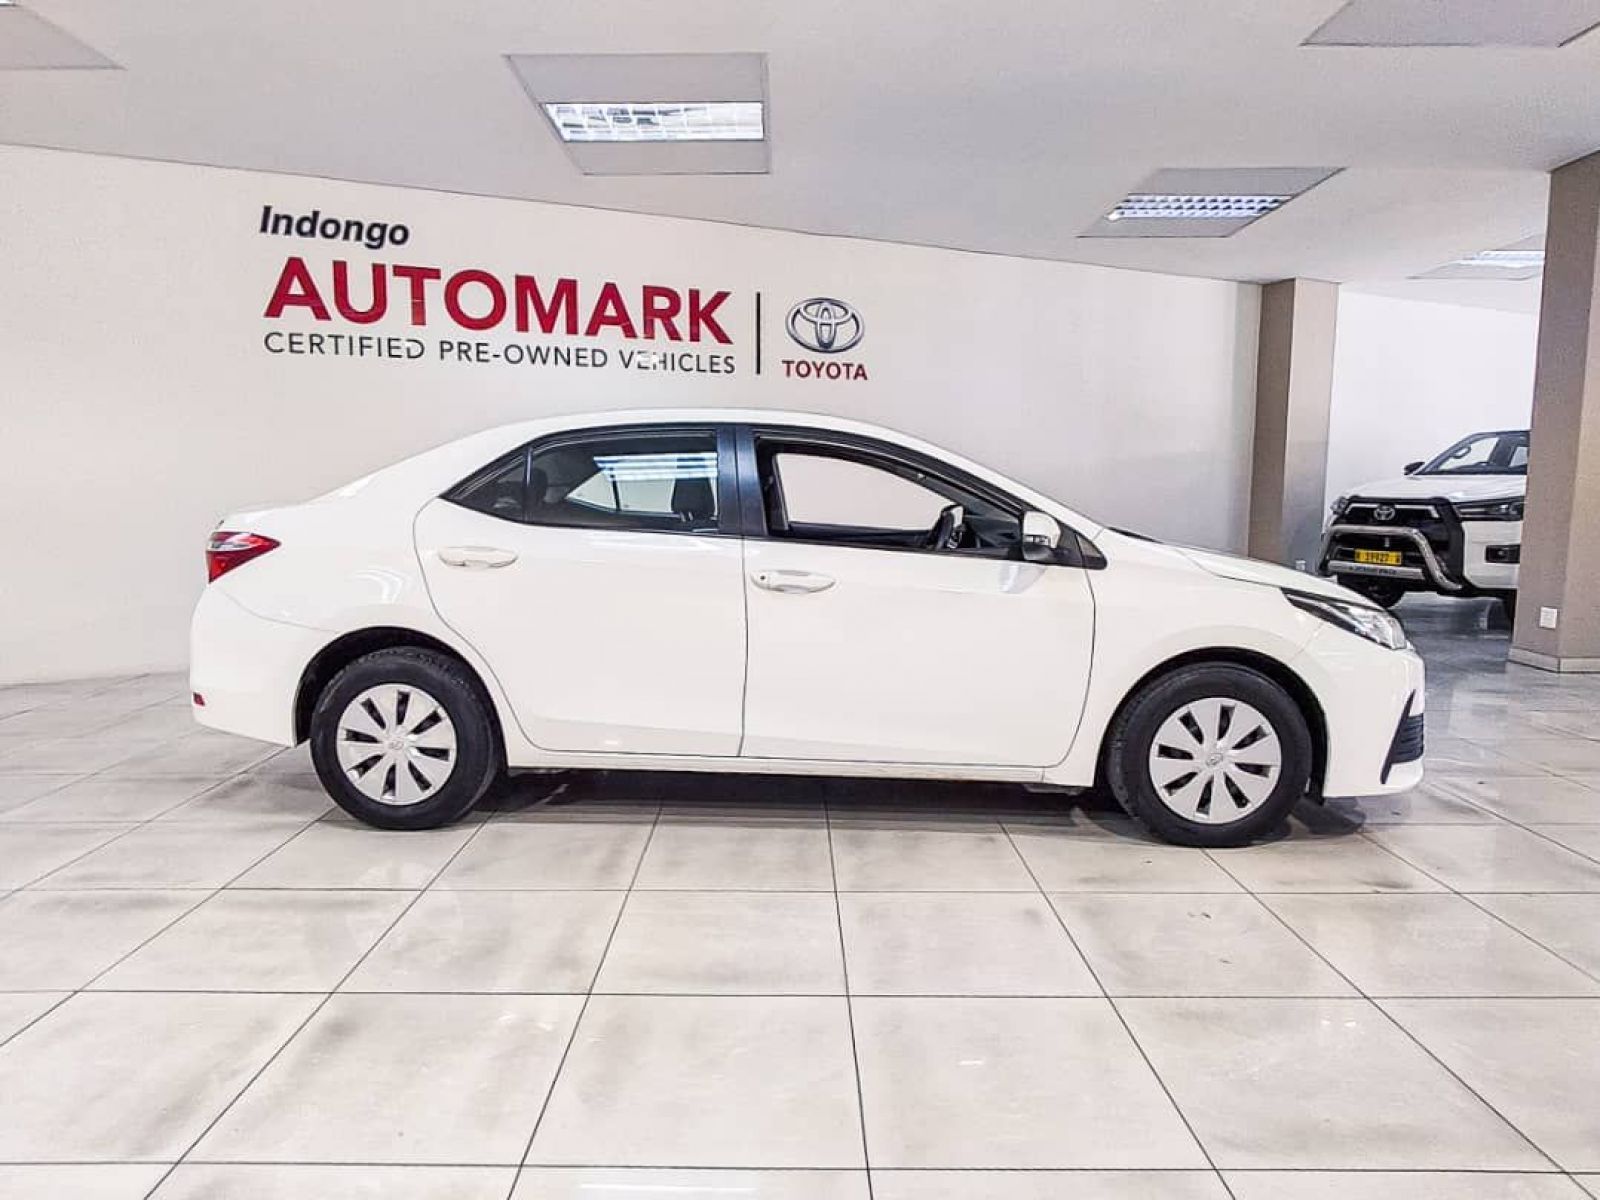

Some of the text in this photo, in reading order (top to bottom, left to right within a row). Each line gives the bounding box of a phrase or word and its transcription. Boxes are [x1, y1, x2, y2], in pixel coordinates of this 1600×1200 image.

[260, 205, 410, 250] Indongo
[264, 256, 734, 345] AUTOMARK
[264, 331, 736, 374] CERTIFIED PRE-OWNED VEHICLES
[782, 359, 868, 381] TOYOTA
